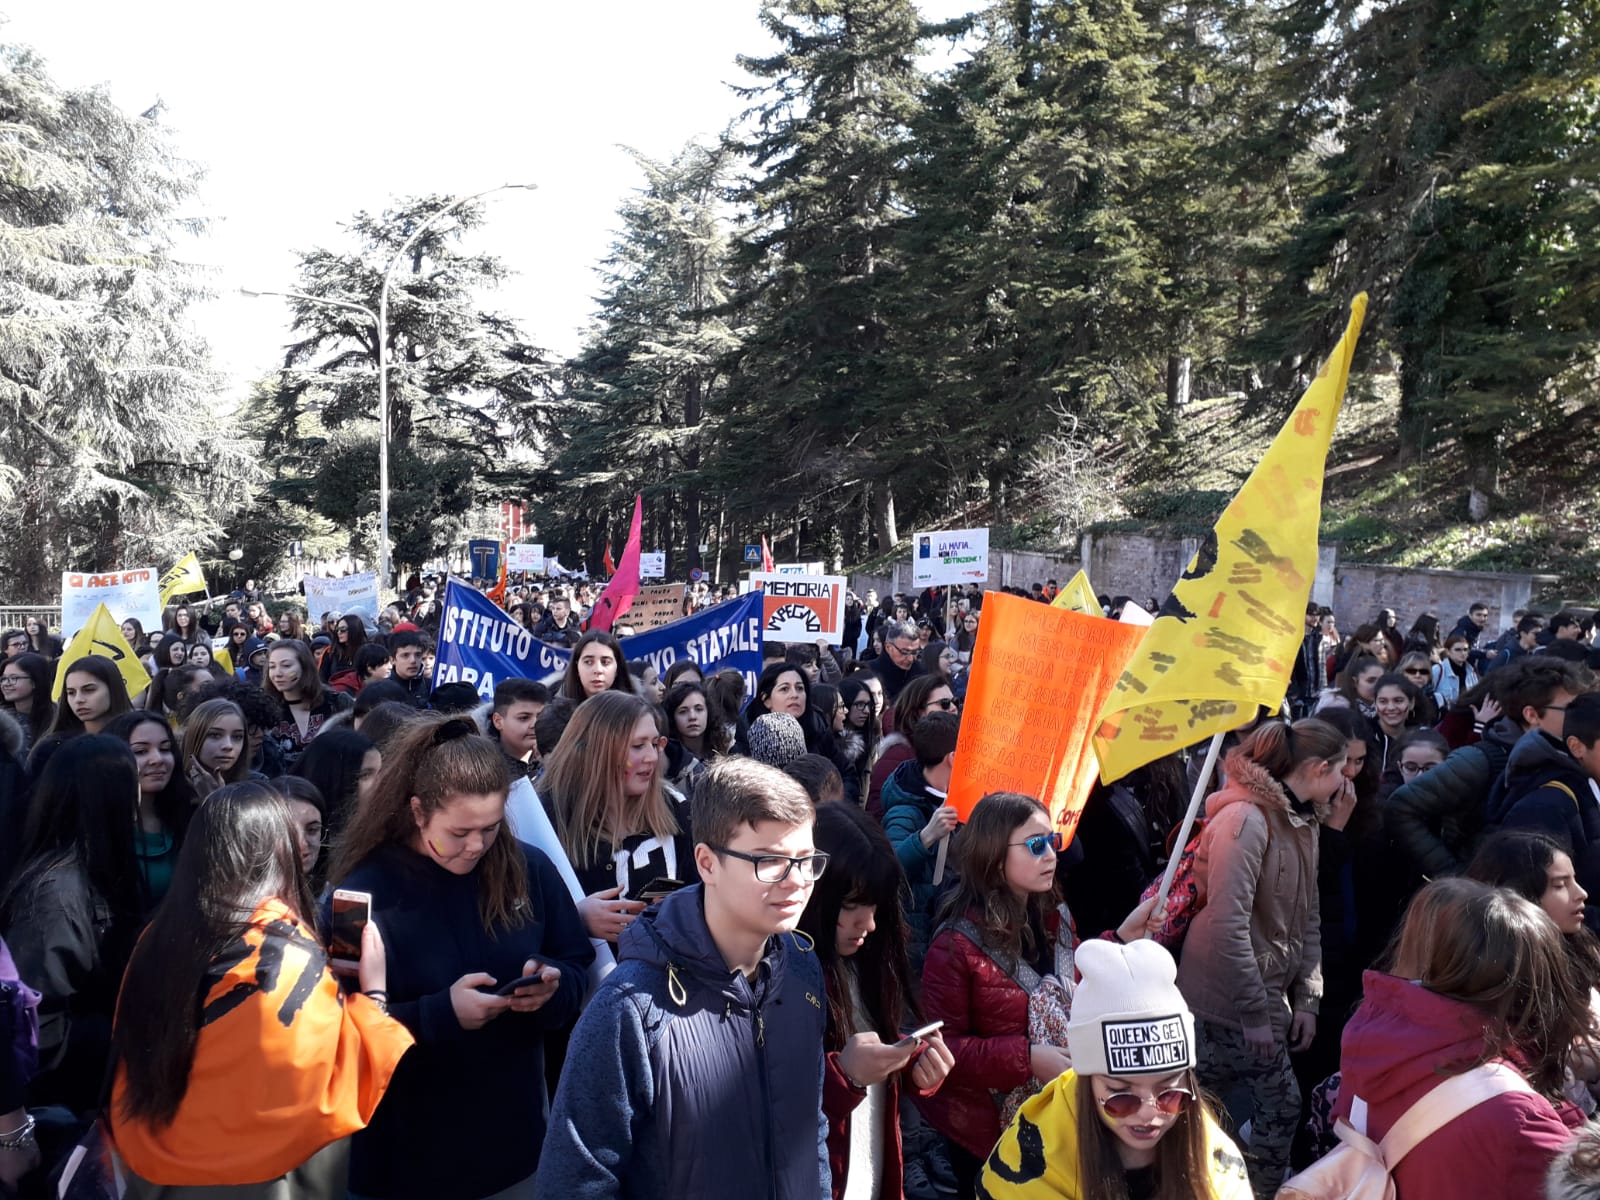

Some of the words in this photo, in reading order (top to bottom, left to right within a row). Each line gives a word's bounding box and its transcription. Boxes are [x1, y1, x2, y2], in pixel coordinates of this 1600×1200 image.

[763, 580, 831, 599] MEMORIA
[767, 603, 821, 633] IMPEGNO
[443, 605, 531, 661] ISTITUTO
[686, 617, 759, 665] STATALE
[1109, 1025, 1160, 1046] QUEENS
[1162, 1022, 1181, 1040] GET
[1112, 1048, 1140, 1068] THE
[1142, 1041, 1185, 1066] MONEY
